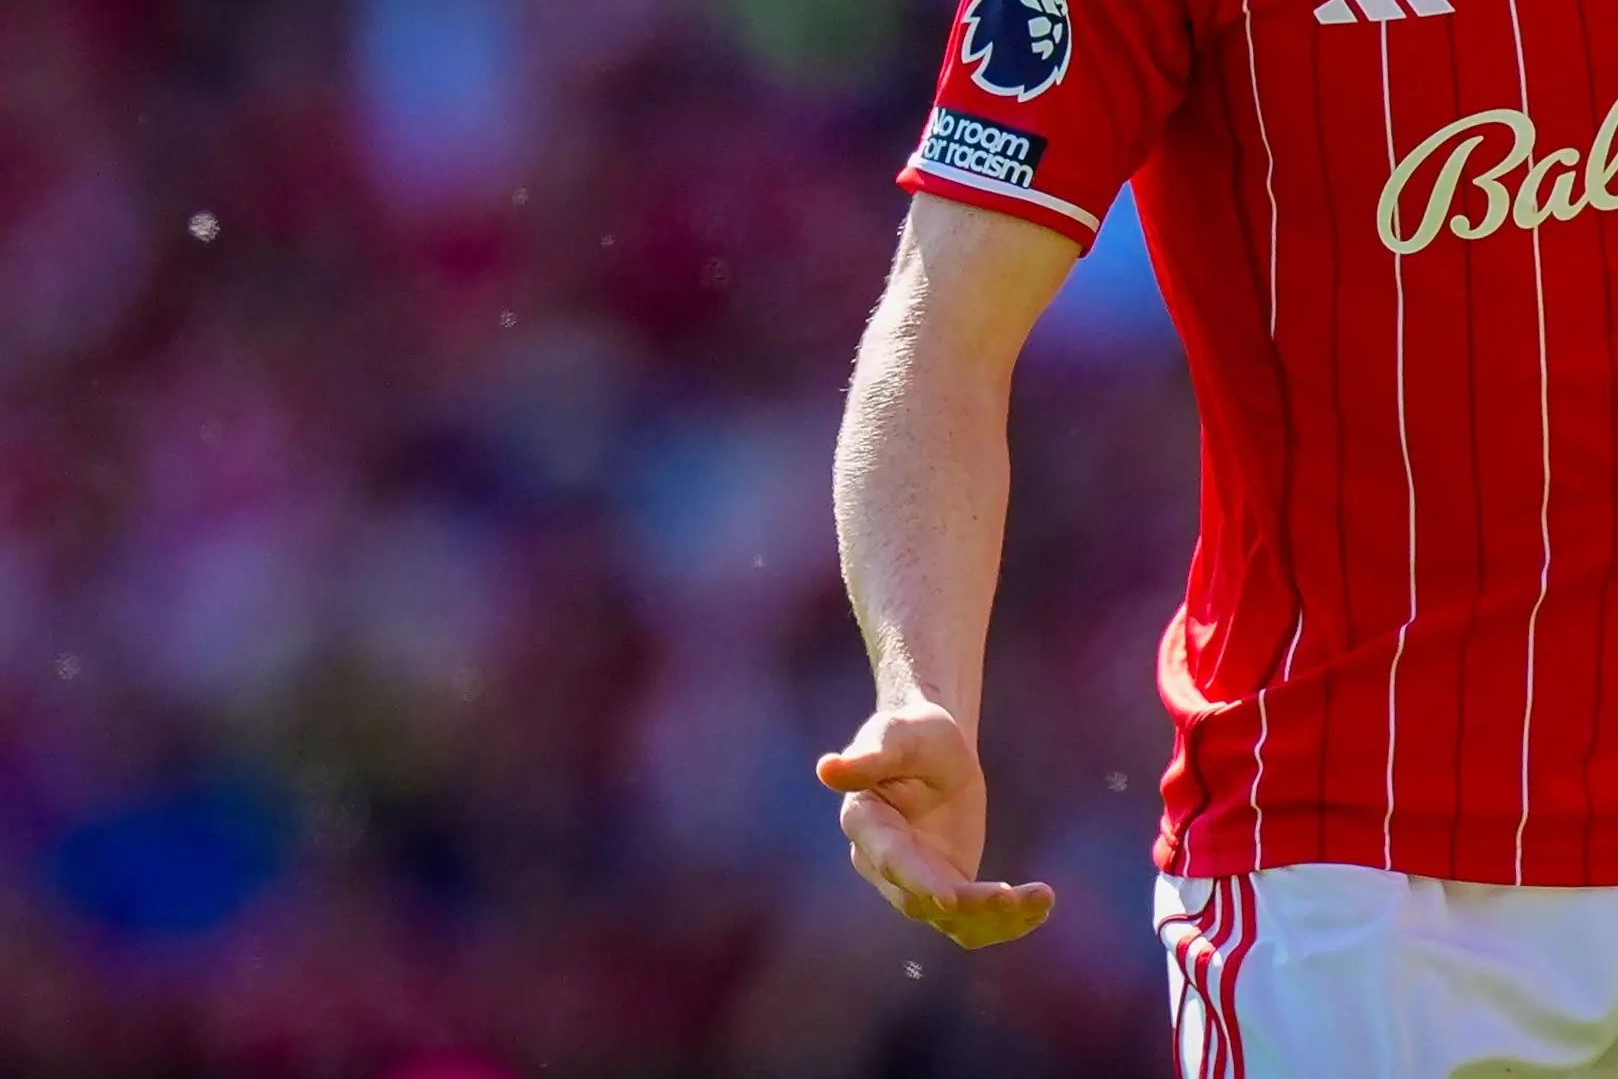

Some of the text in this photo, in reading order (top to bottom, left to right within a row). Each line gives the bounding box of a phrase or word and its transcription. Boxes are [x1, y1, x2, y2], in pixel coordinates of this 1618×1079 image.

[922, 137, 1034, 188] or racism
[954, 119, 1030, 160] room
